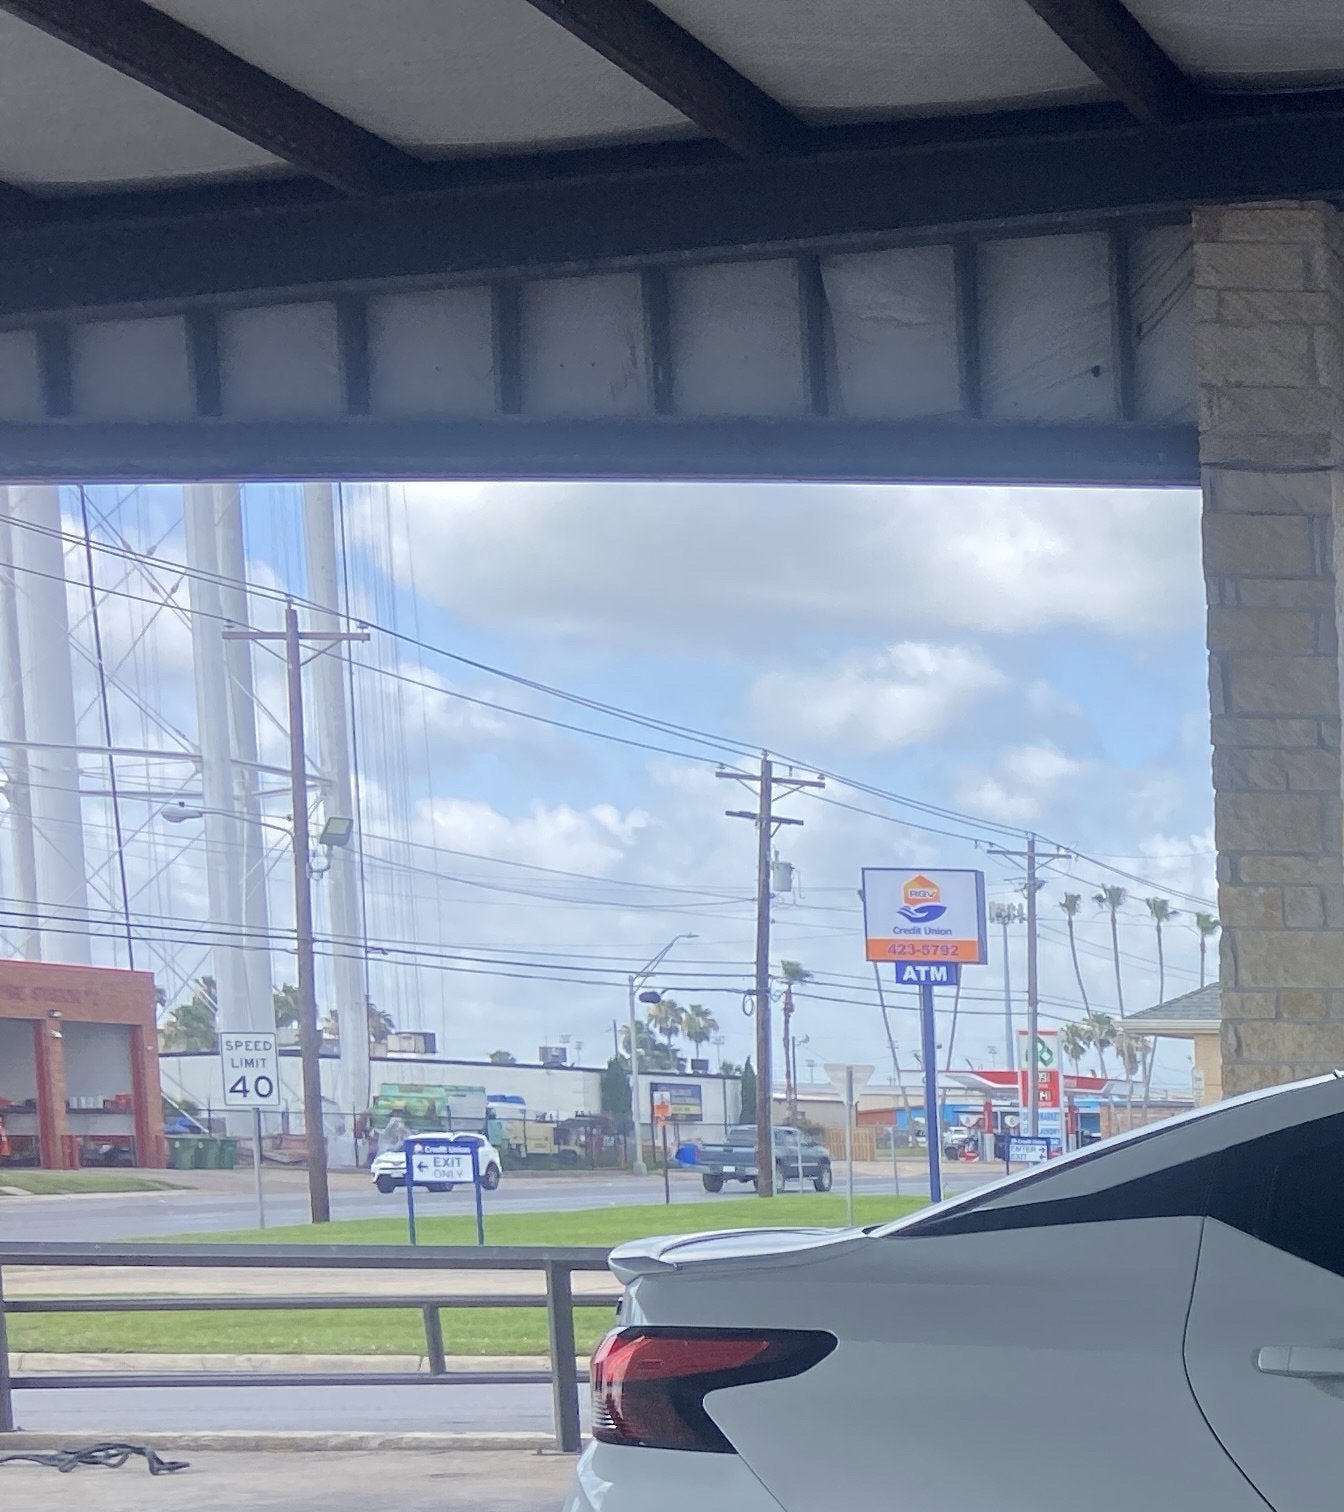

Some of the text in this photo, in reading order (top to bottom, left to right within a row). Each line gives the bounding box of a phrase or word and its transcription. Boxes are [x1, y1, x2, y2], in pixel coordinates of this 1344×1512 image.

[909, 889, 936, 898] RGV
[892, 926, 953, 936] Credit Union
[887, 943, 960, 957] 423-5792
[902, 965, 948, 982] ATM
[225, 1040, 273, 1051] SPEED
[231, 1057, 267, 1069] LIMIT
[228, 1075, 274, 1098] 40
[433, 1156, 463, 1168] EXIT
[433, 1169, 464, 1179] ONLY
